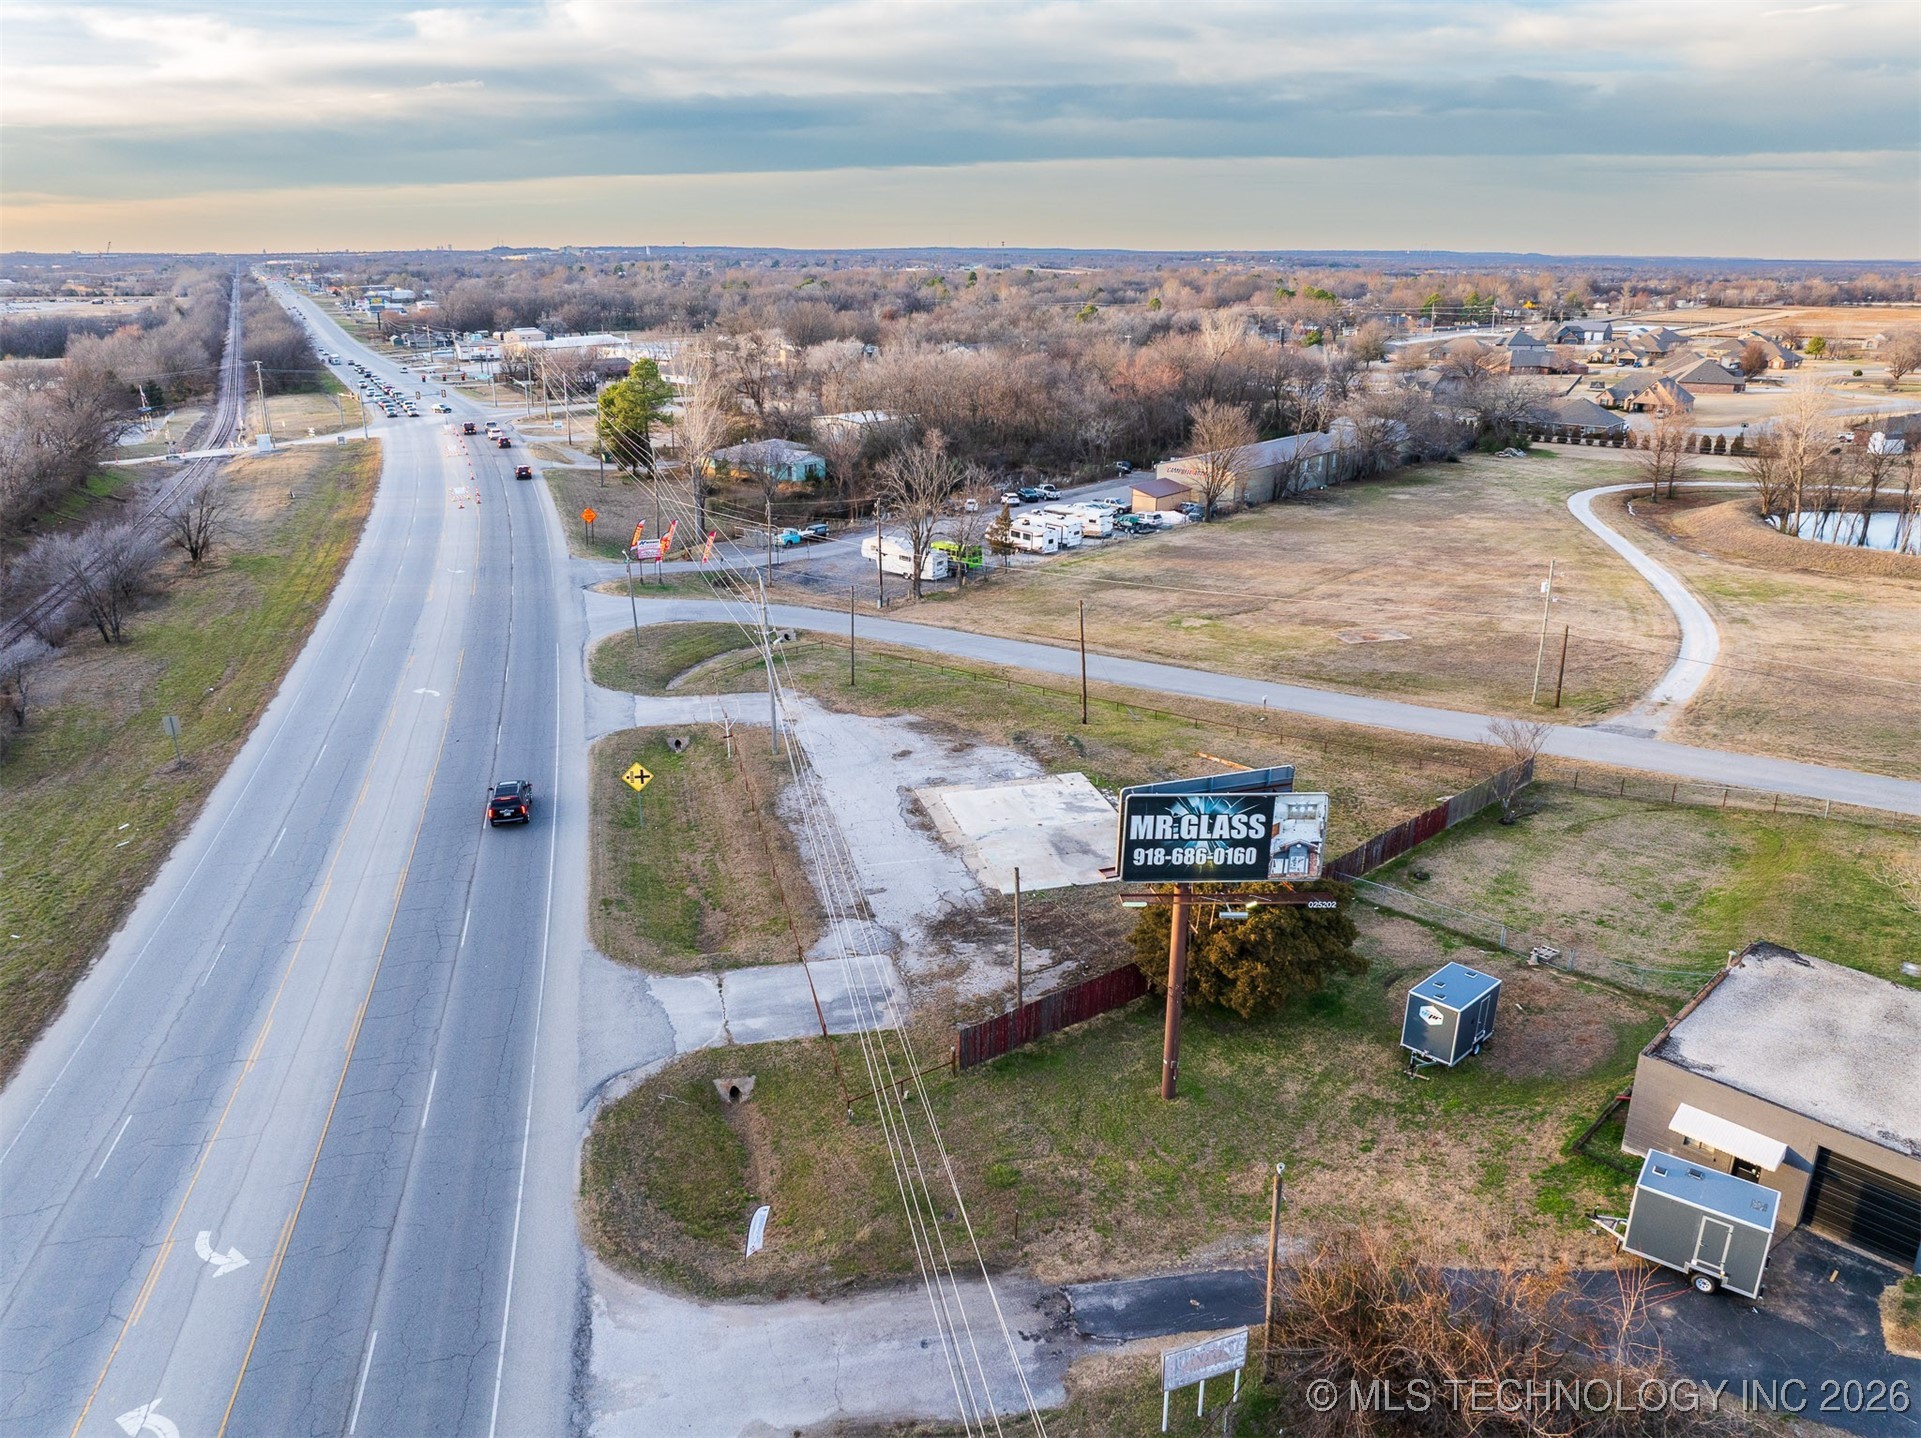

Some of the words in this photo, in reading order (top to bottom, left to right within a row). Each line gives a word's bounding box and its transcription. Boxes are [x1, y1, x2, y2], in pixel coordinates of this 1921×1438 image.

[1180, 813, 1266, 840] GLASS
[1133, 847, 1257, 865] 918-686-0160
[1308, 901, 1337, 909] 025202
